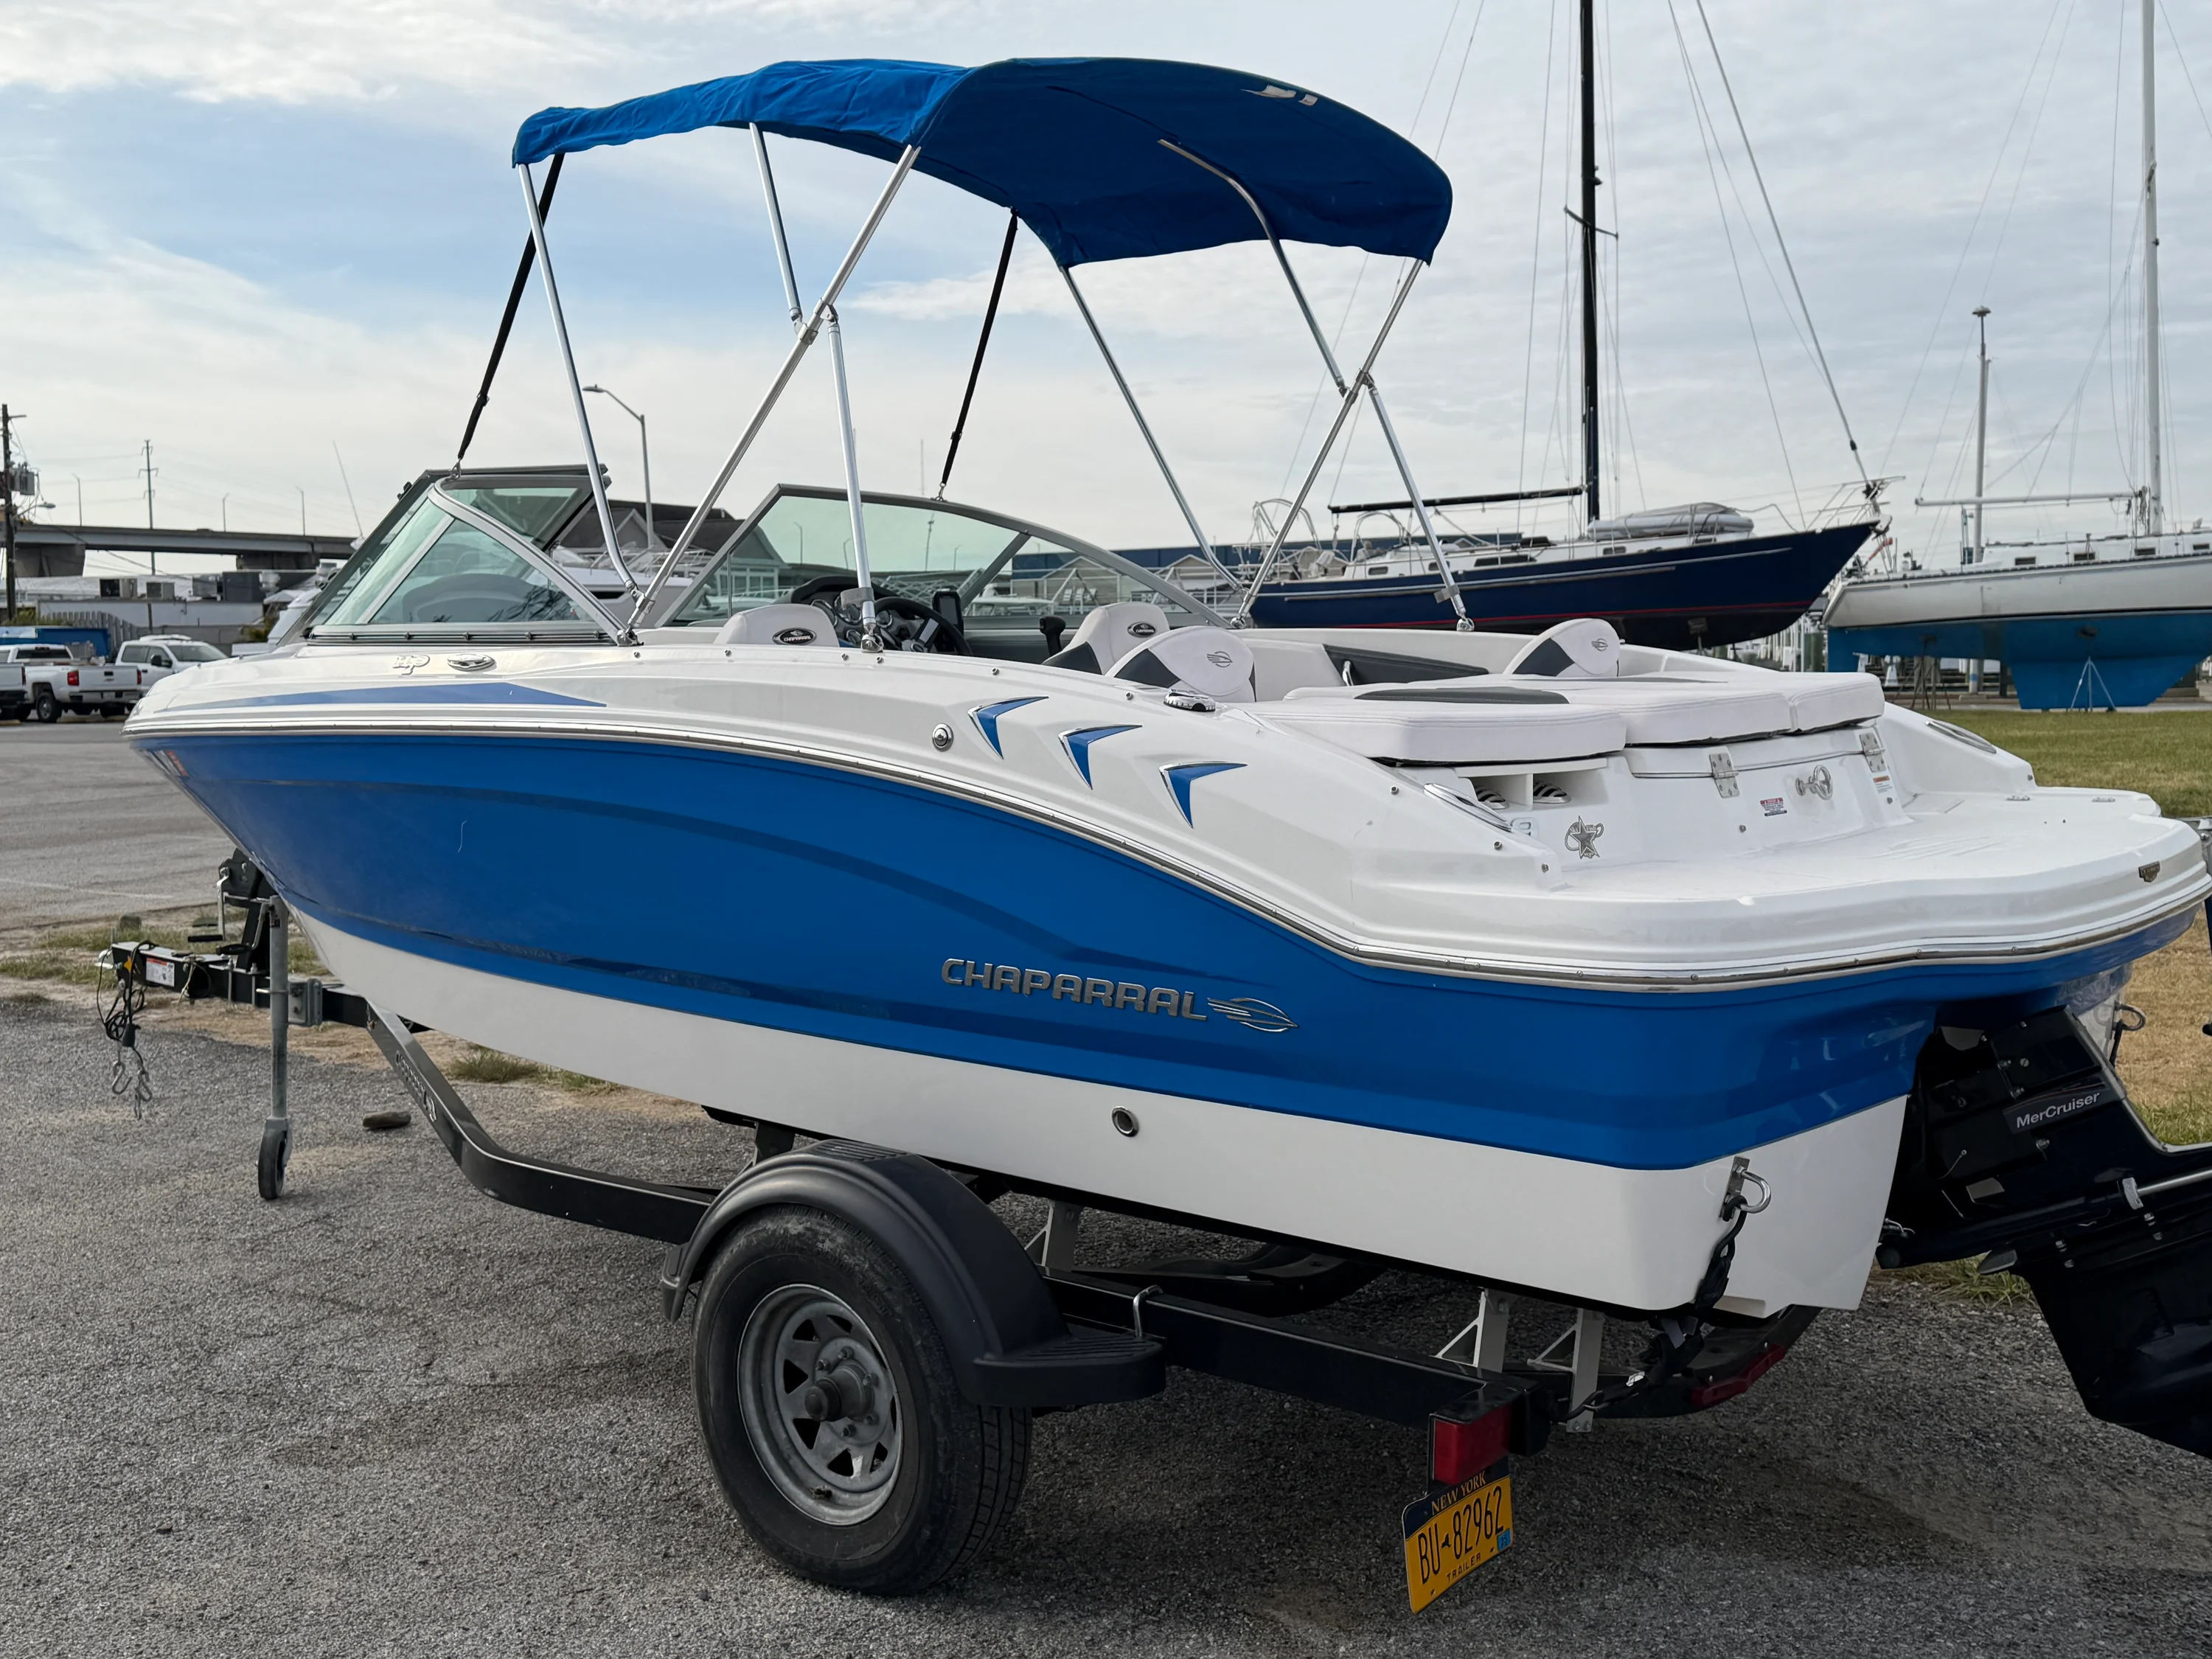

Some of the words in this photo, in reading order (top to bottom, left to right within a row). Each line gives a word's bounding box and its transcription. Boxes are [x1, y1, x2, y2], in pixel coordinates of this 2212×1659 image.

[942, 959, 1208, 1021] CHAPARRAL
[2017, 1092, 2100, 1128] MerCruiser
[1430, 1489, 1458, 1515] NEW
[1460, 1471, 1486, 1499] YORK
[1446, 1552, 1481, 1583] TRAILER
